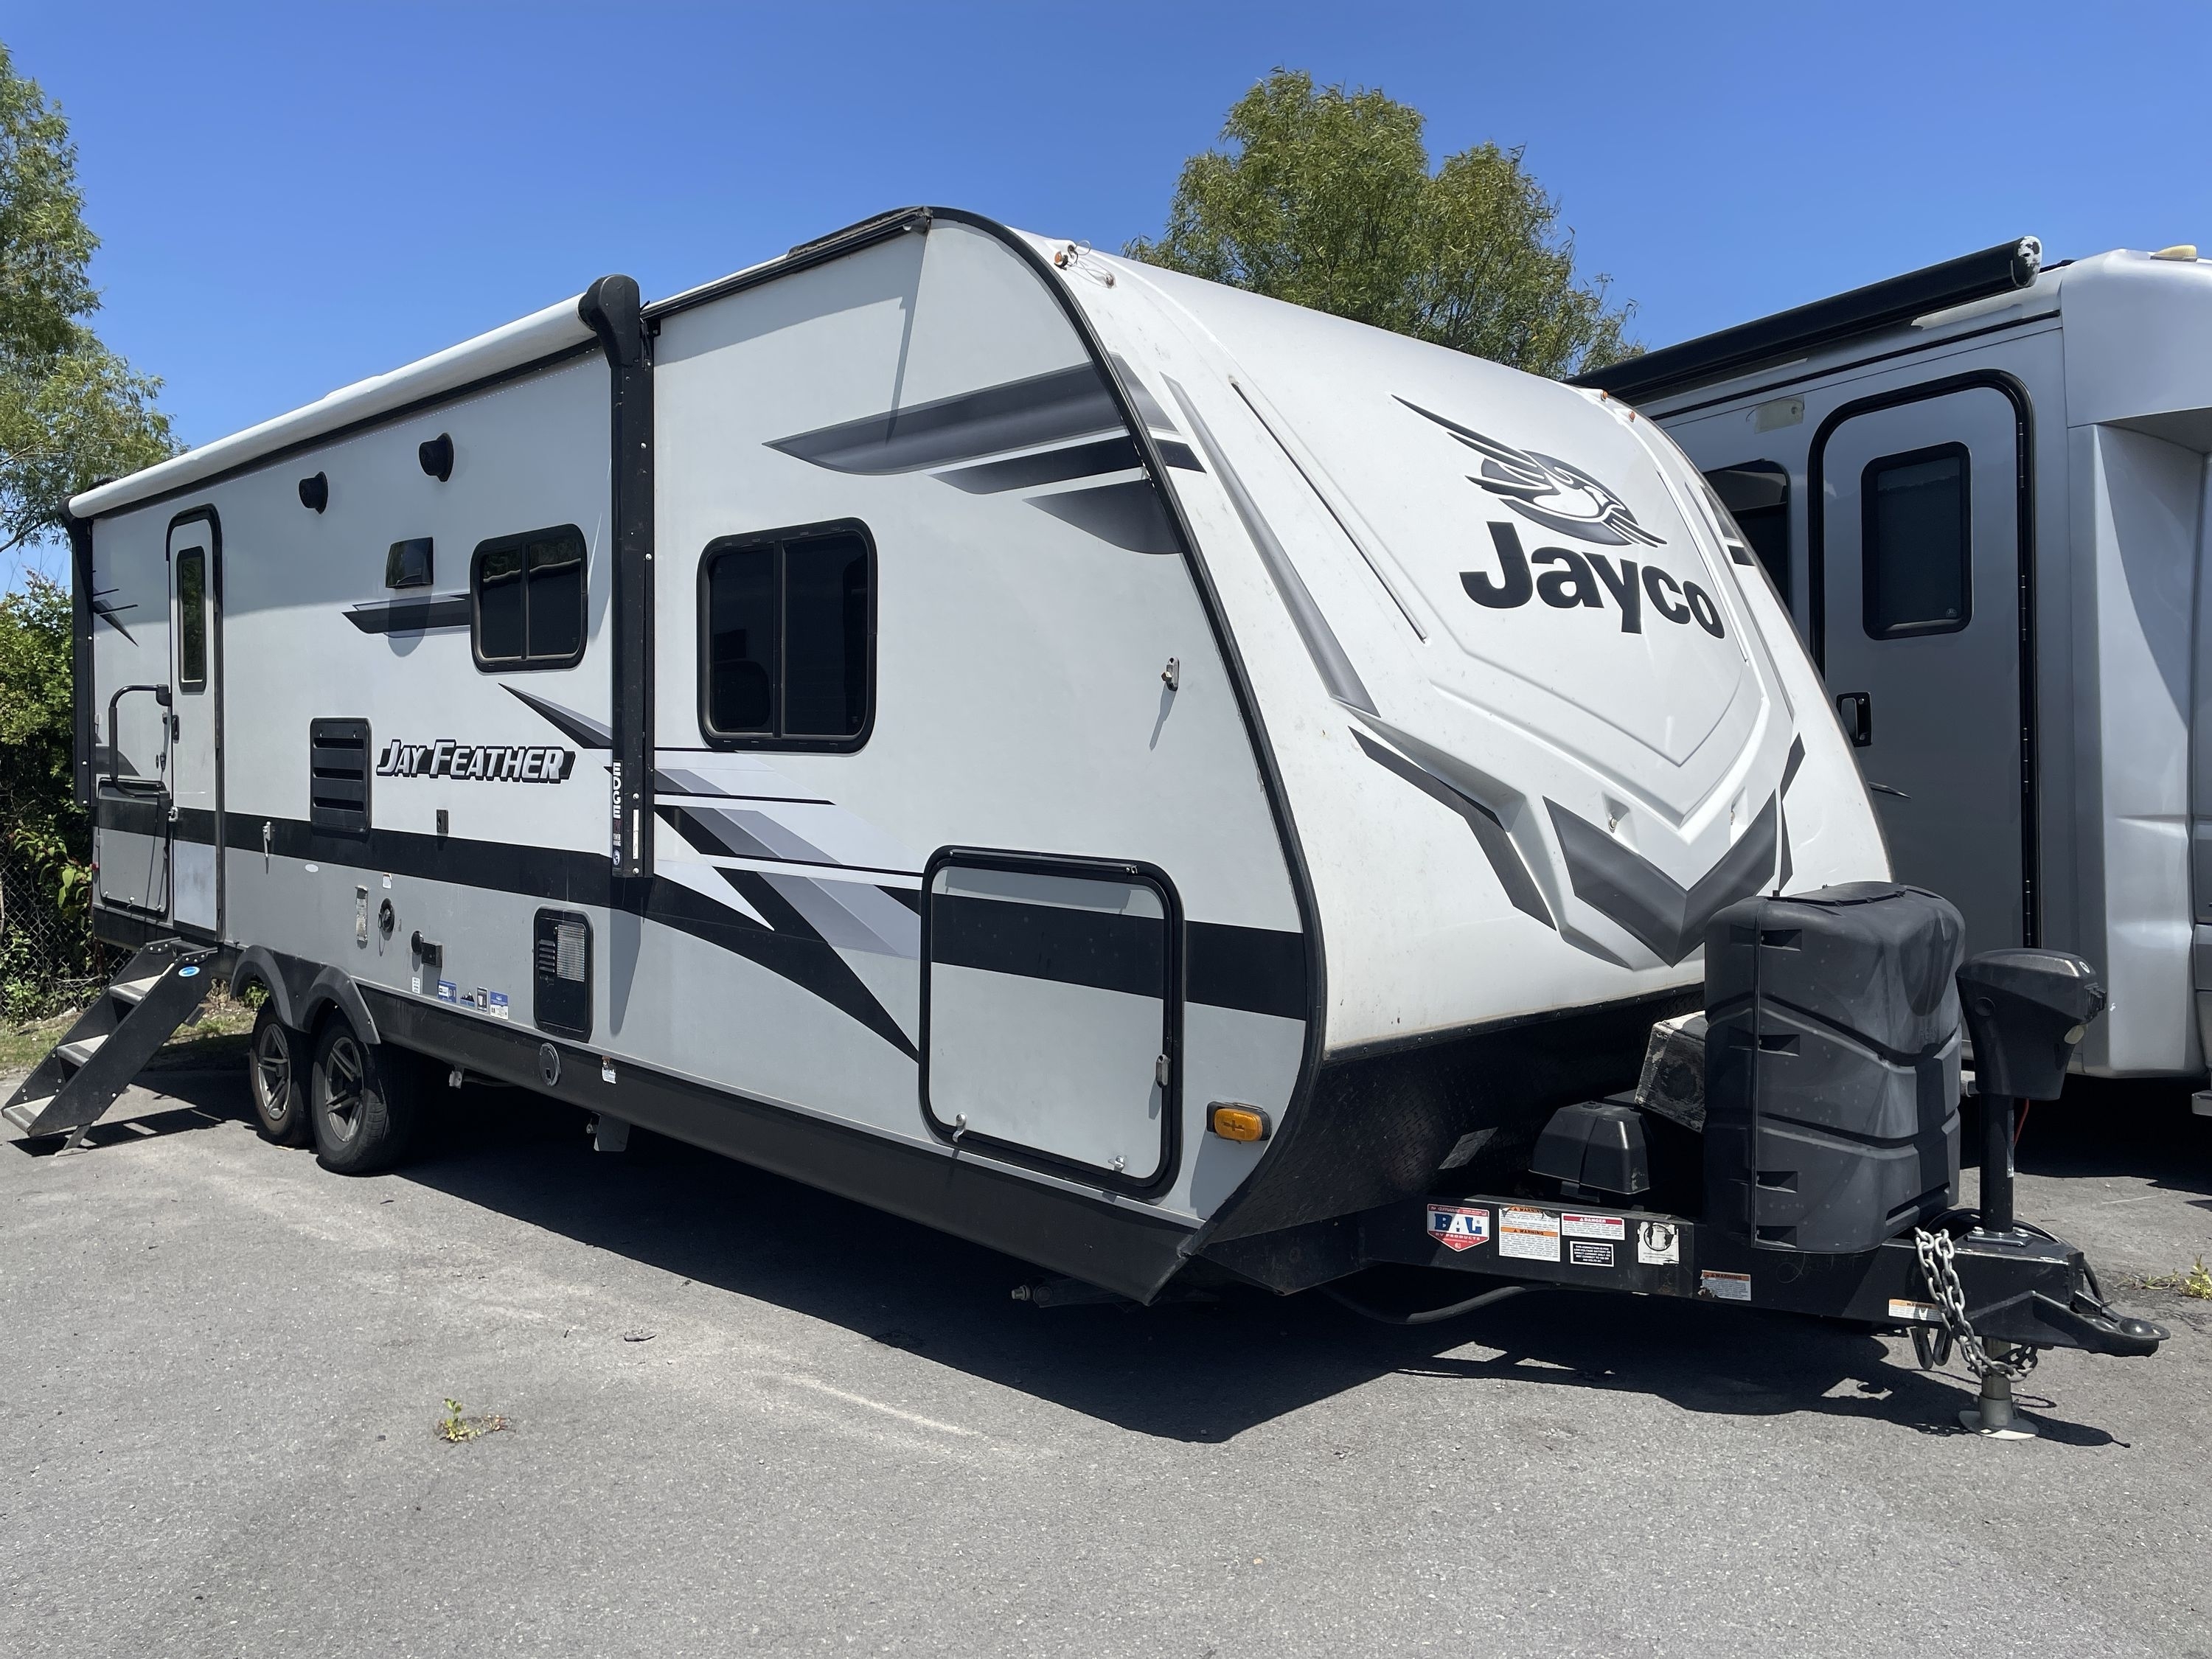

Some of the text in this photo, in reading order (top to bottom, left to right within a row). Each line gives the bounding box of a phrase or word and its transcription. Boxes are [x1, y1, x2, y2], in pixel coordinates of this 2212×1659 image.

[1458, 521, 1725, 639] Jayco
[376, 739, 565, 784] JAY FEATHER
[613, 762, 622, 819] EDGE
[1434, 1213, 1482, 1234] BAL
